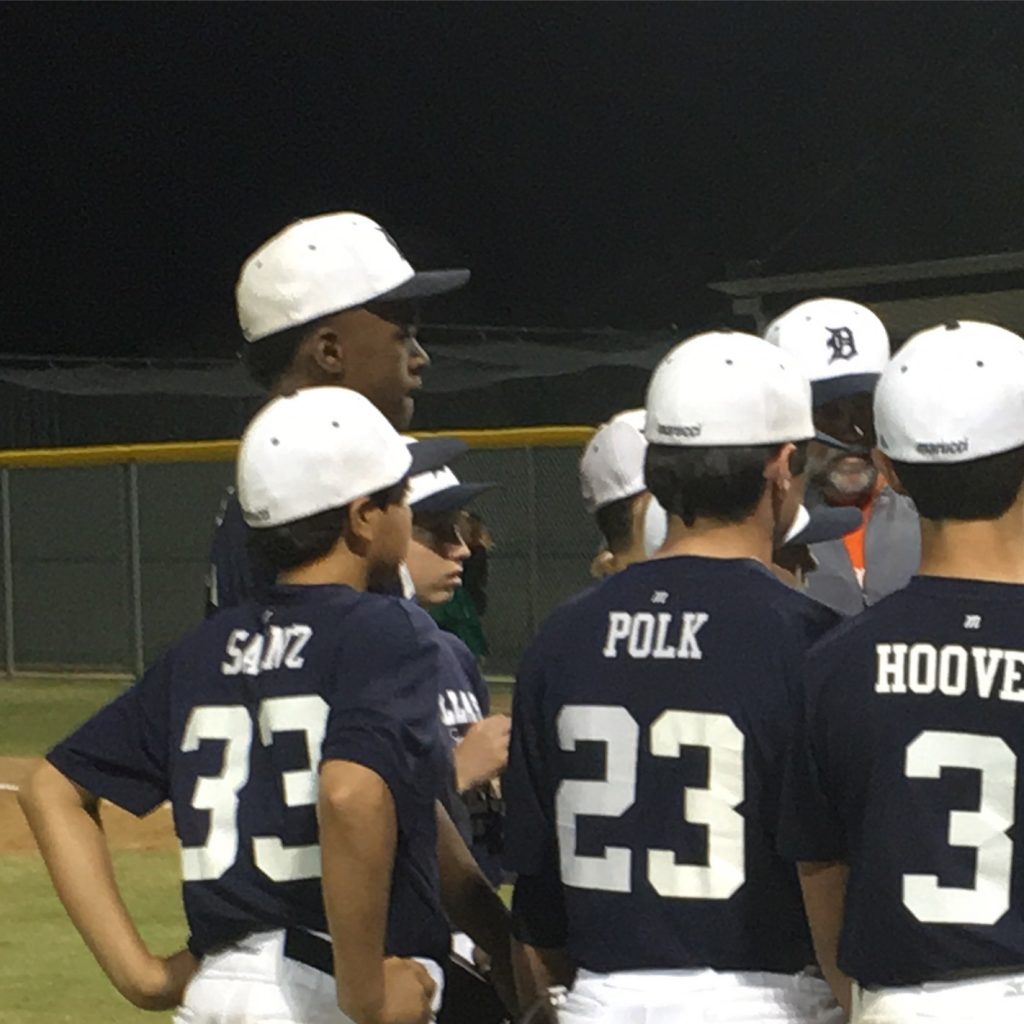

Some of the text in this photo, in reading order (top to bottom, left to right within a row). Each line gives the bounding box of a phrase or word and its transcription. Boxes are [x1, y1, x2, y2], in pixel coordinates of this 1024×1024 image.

[220, 624, 313, 676] SANZ
[603, 612, 710, 659] POLK
[180, 694, 331, 882] 33
[555, 705, 746, 899] 23
[902, 730, 1017, 925] 3
